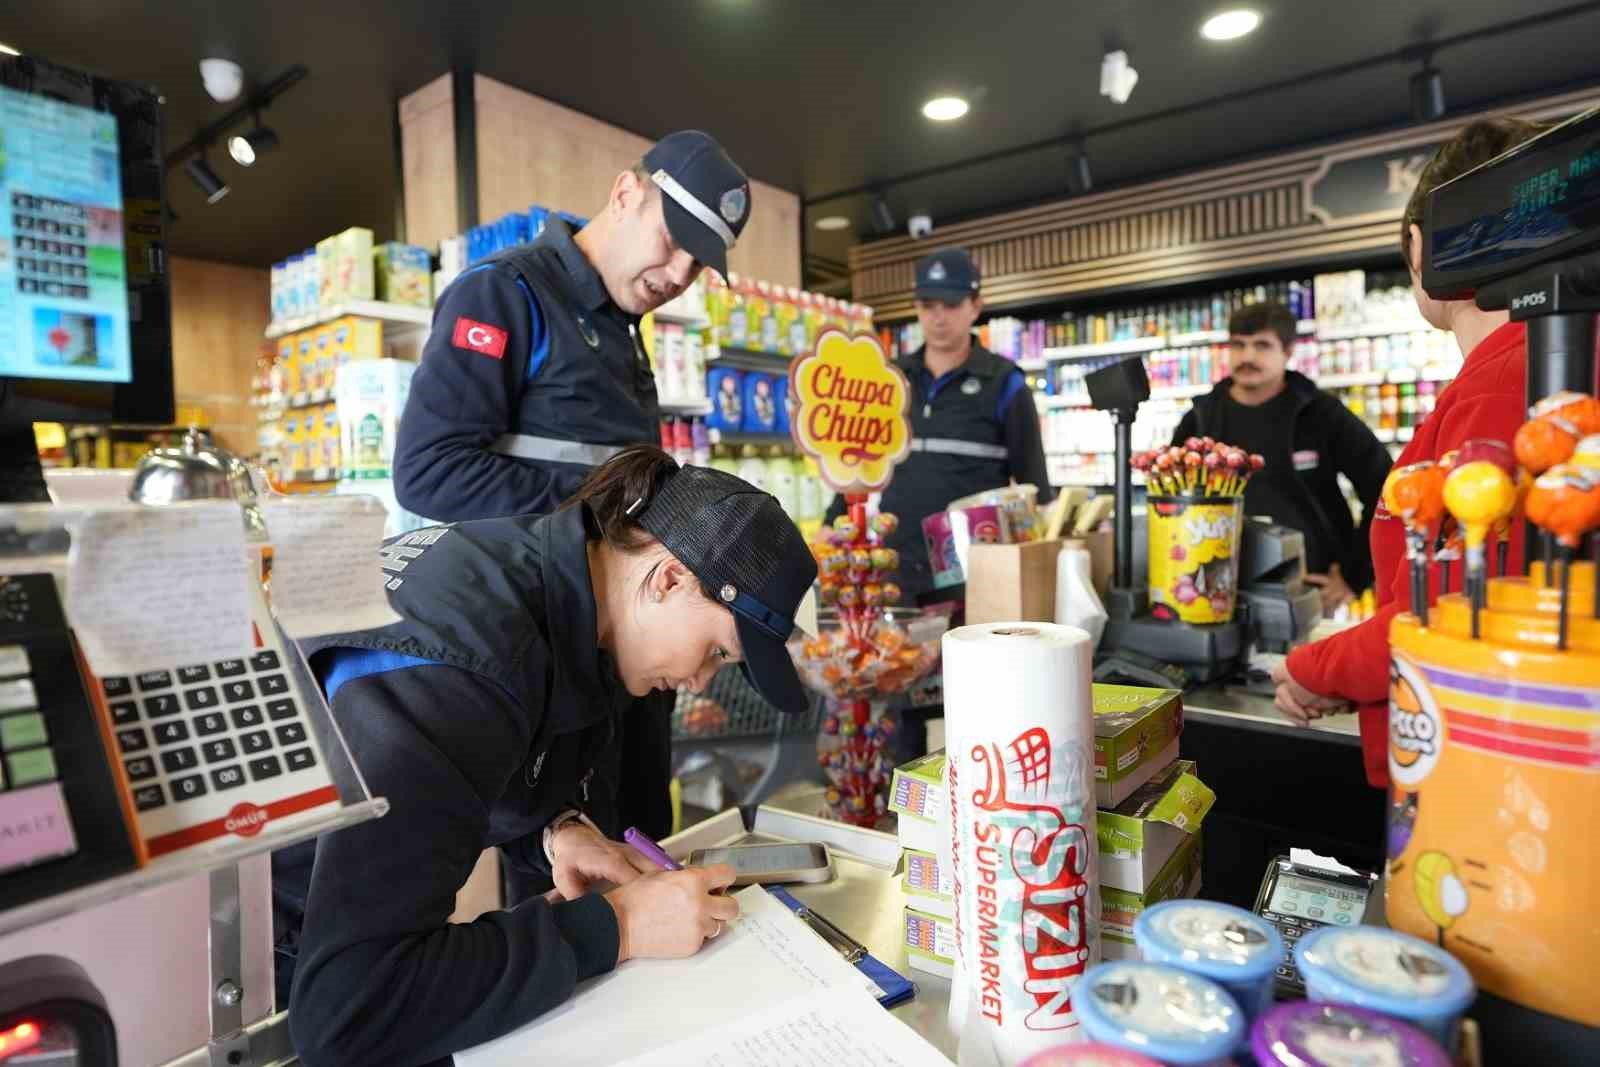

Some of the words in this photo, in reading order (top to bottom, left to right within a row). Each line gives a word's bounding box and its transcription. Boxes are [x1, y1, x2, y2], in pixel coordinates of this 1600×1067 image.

[811, 363, 895, 413] Chupa
[808, 403, 893, 464] Chups
[158, 699, 169, 711] 7
[233, 684, 244, 697] 9
[166, 725, 178, 737] 4
[242, 710, 254, 722] 6
[213, 743, 225, 756] 2
[252, 735, 263, 747] 3
[973, 820, 1003, 1028] SÜPERMARKET
